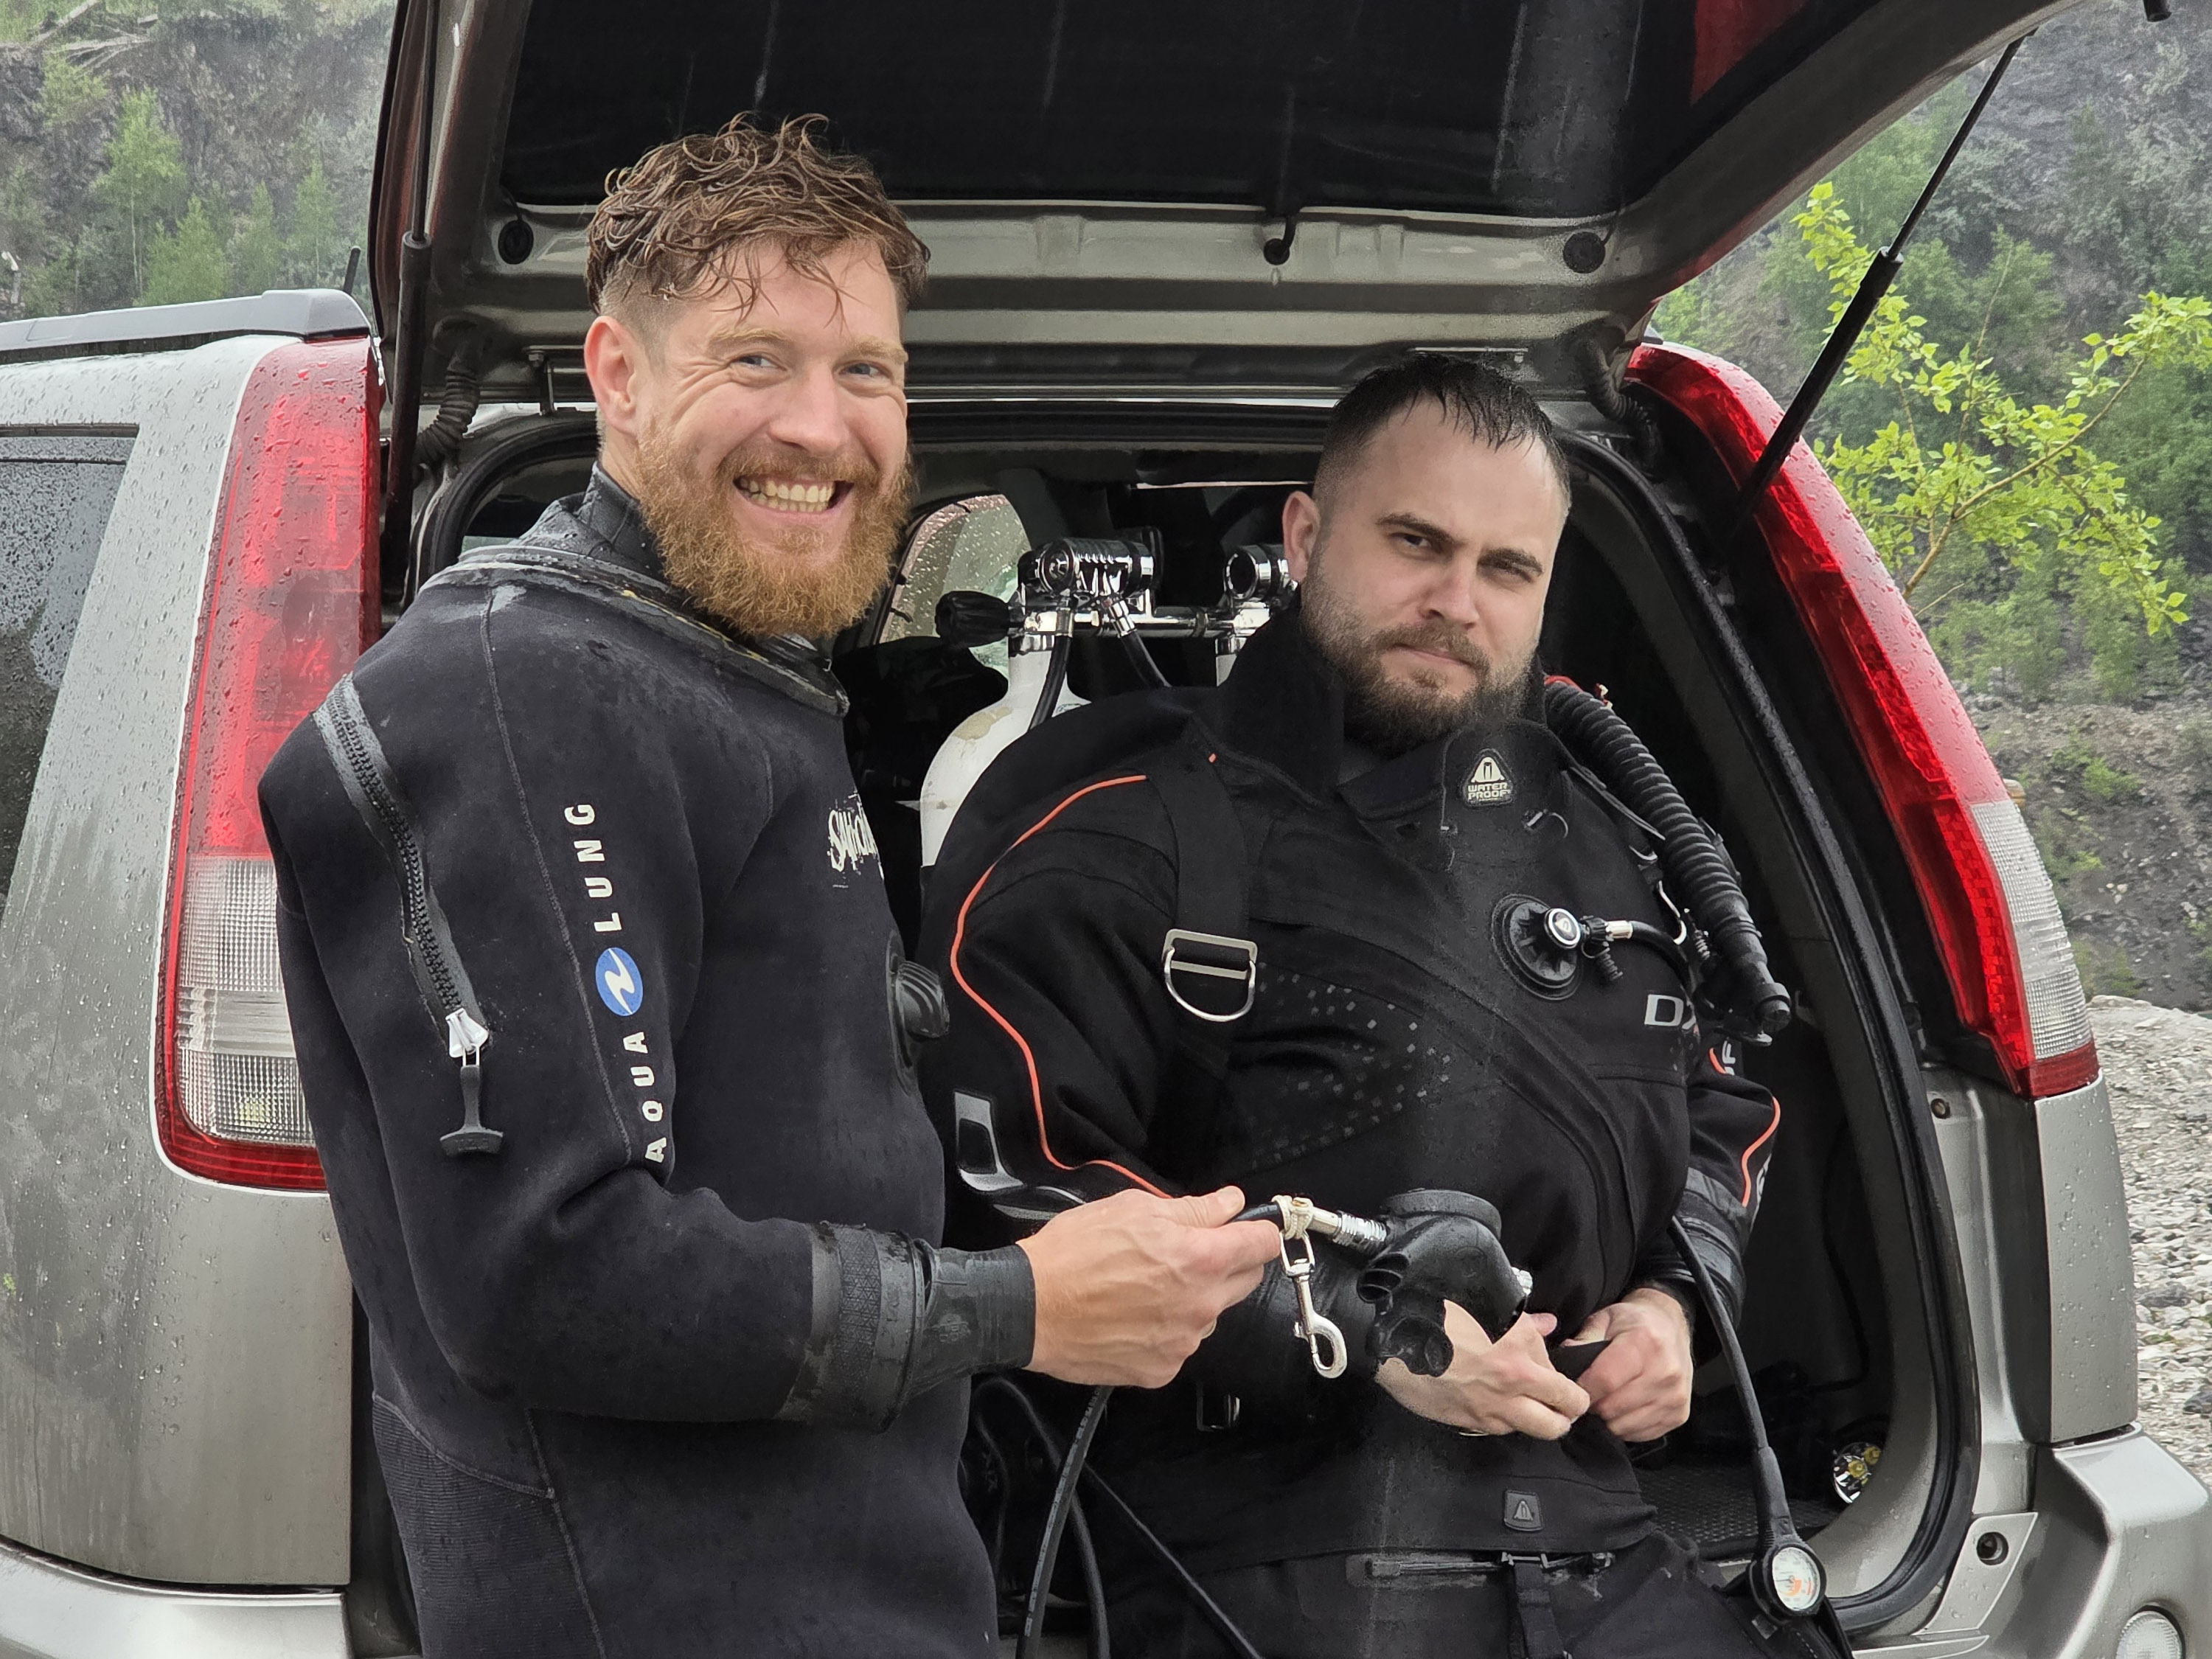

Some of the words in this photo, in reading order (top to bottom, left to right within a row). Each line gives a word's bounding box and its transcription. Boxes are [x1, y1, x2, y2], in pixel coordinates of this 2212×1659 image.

[1467, 782, 1508, 793] WATER
[1467, 789, 1512, 801] PROOF
[563, 804, 622, 932] LUNG
[622, 1032, 667, 1163] AQUA
